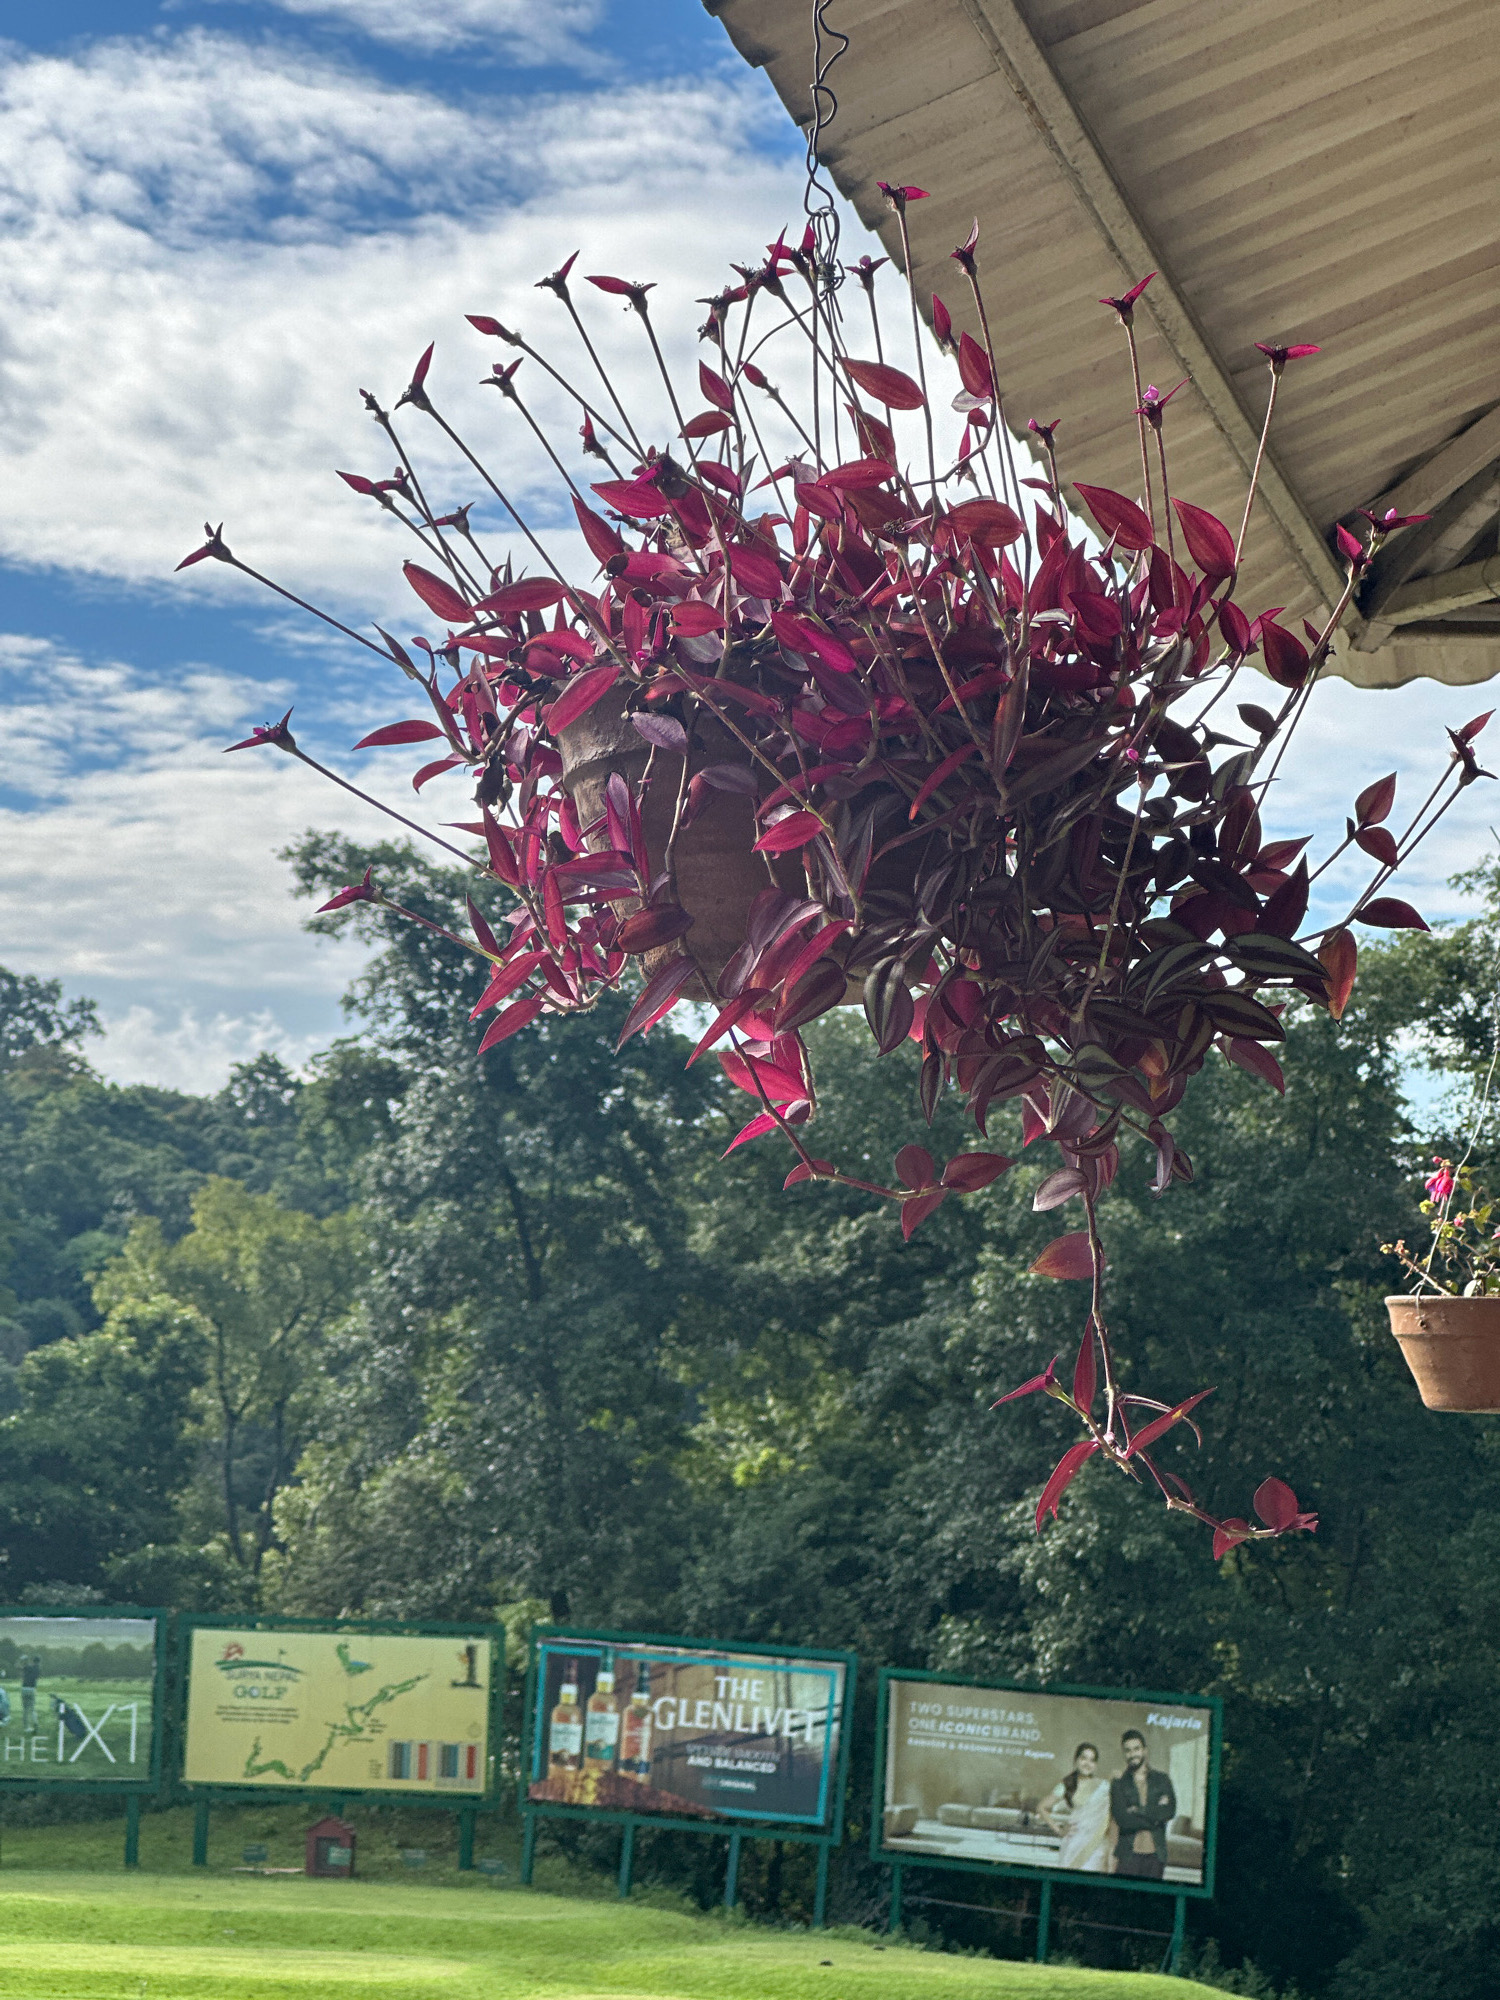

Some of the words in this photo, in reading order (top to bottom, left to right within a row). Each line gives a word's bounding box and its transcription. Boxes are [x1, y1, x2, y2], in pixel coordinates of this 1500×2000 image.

[714, 1675, 764, 1702] THE
[651, 1696, 829, 1743] GLENLIVET
[909, 1701, 943, 1717] TWO
[1146, 1712, 1202, 1730] Kajaria
[908, 1717, 937, 1731] ONE
[938, 1720, 992, 1738] ICONIC
[3, 1735, 49, 1763] HE
